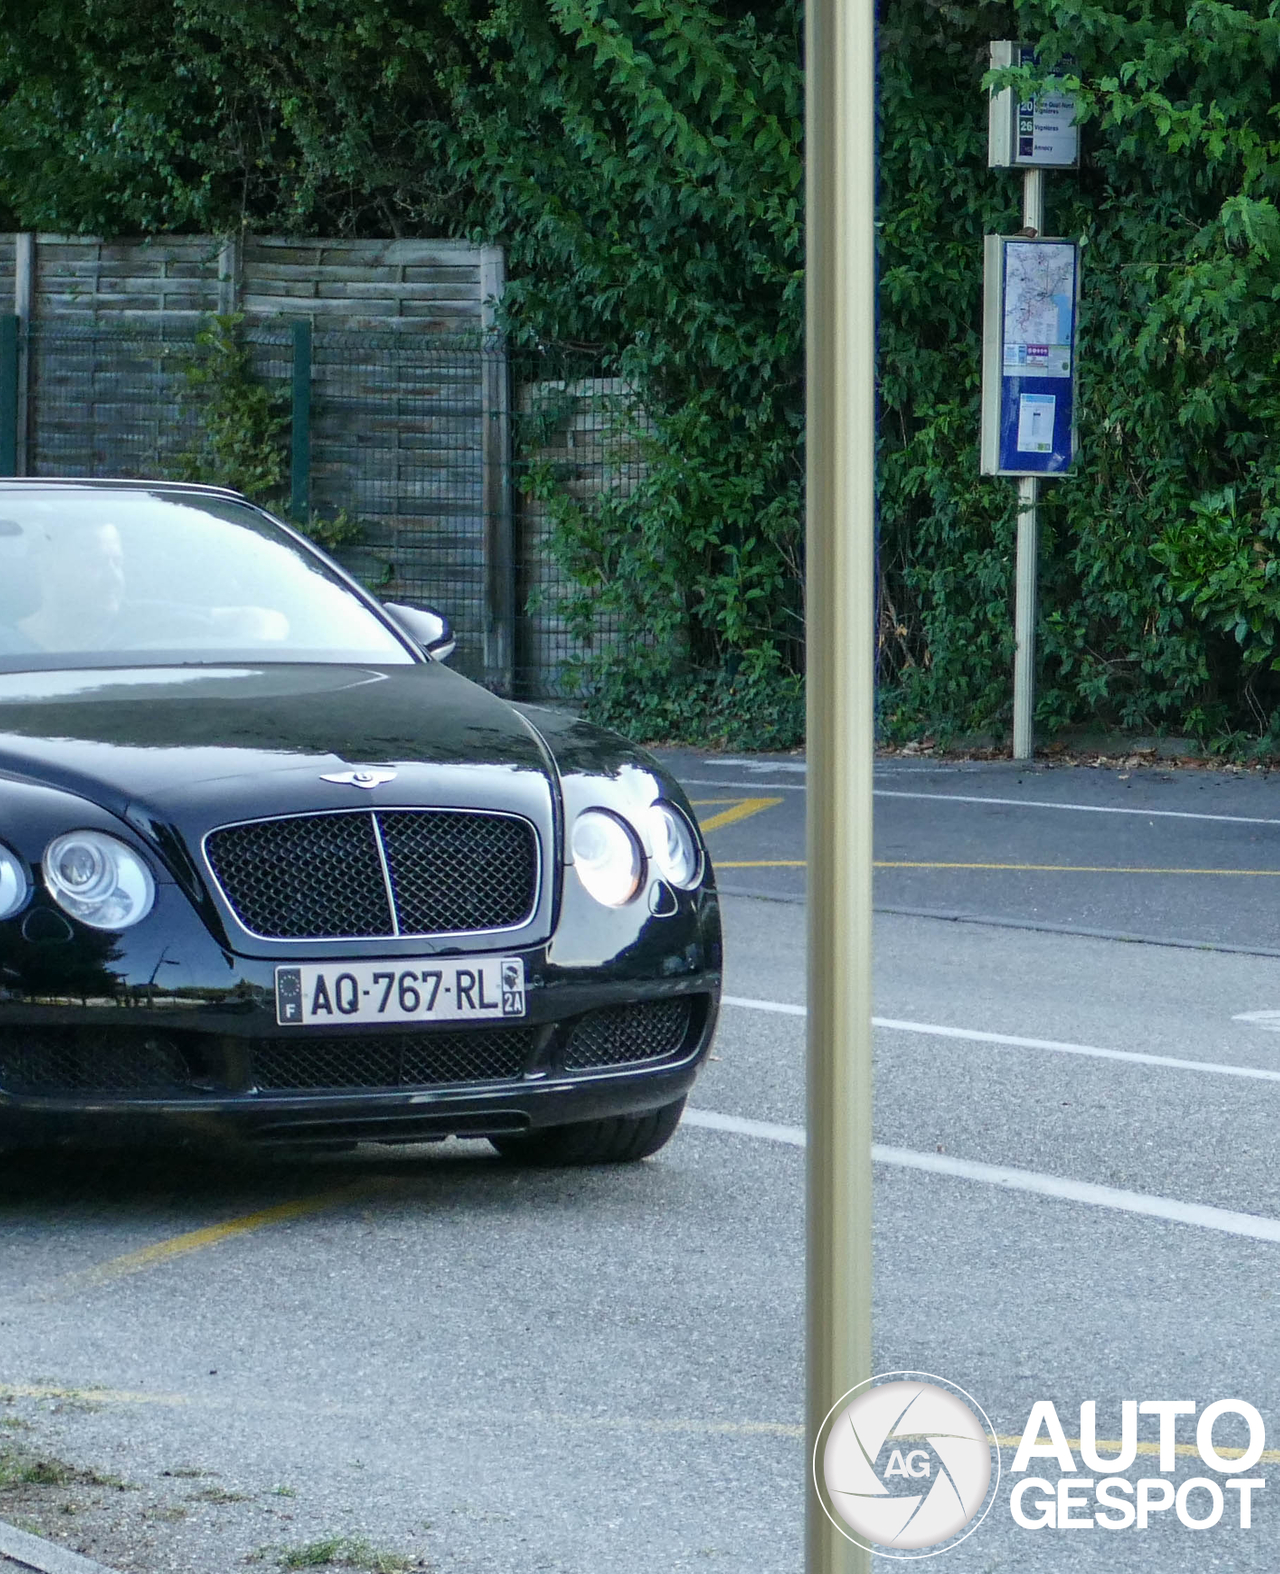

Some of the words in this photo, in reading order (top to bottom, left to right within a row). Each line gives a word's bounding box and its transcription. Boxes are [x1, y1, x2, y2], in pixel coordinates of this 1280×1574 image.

[1020, 121, 1033, 131] 26
[311, 969, 498, 1015] AQ-767-RL
[286, 1003, 295, 1018] F
[504, 993, 522, 1012] 2A
